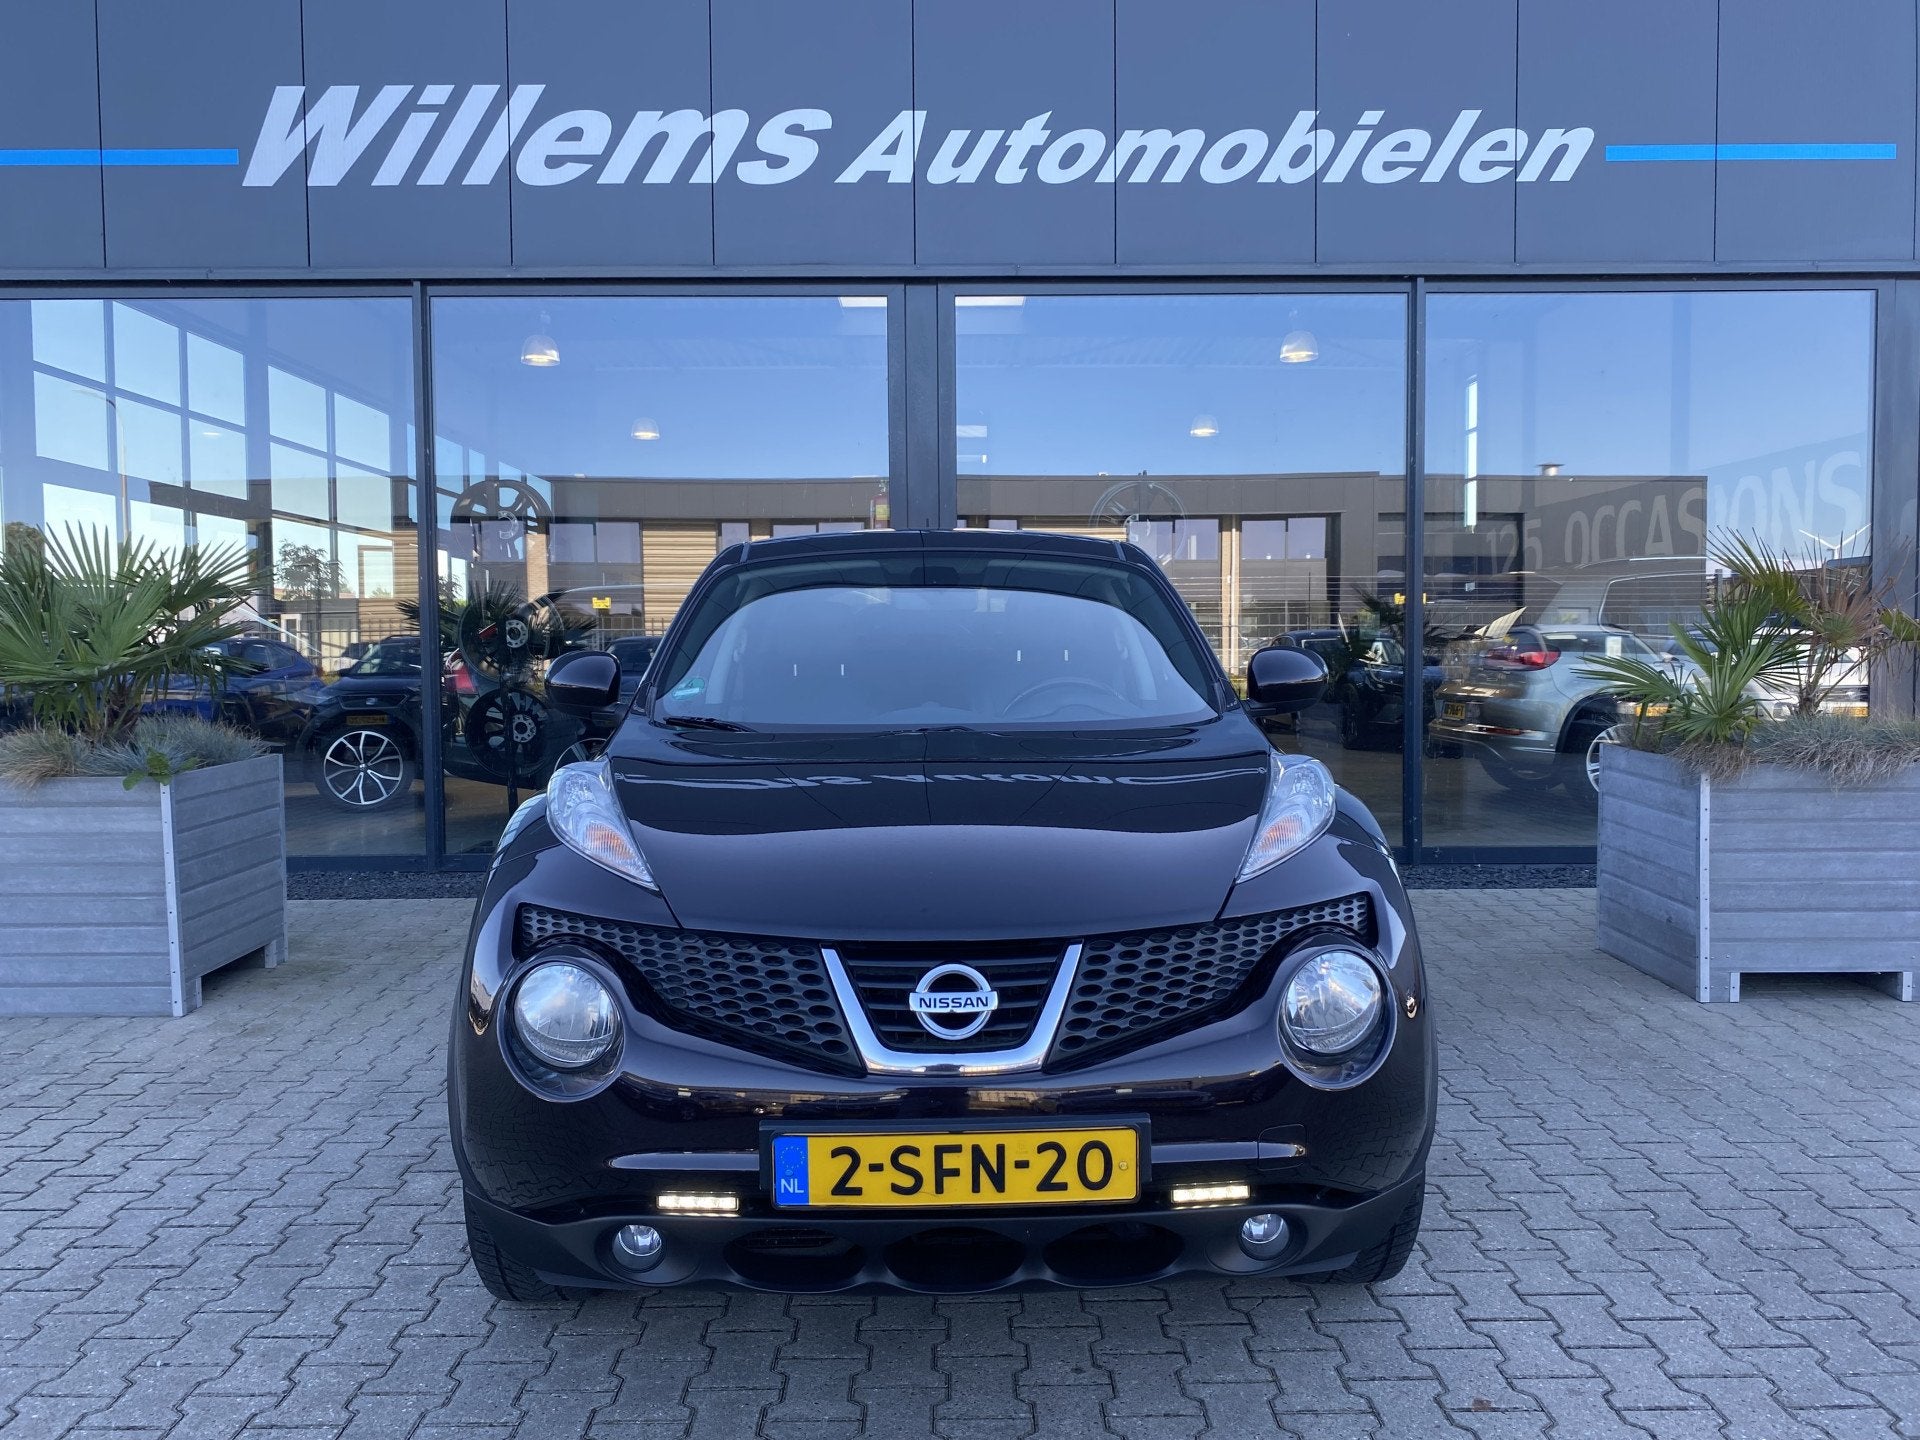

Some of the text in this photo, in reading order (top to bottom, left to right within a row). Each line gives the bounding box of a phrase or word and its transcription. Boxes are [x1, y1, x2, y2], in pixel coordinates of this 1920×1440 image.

[242, 84, 1595, 187] Willems Automobielen
[1486, 450, 1864, 576] 125 OCCASIONS
[919, 996, 989, 1009] NISSAN
[780, 1139, 1114, 1197] NL 2-SFN-20
